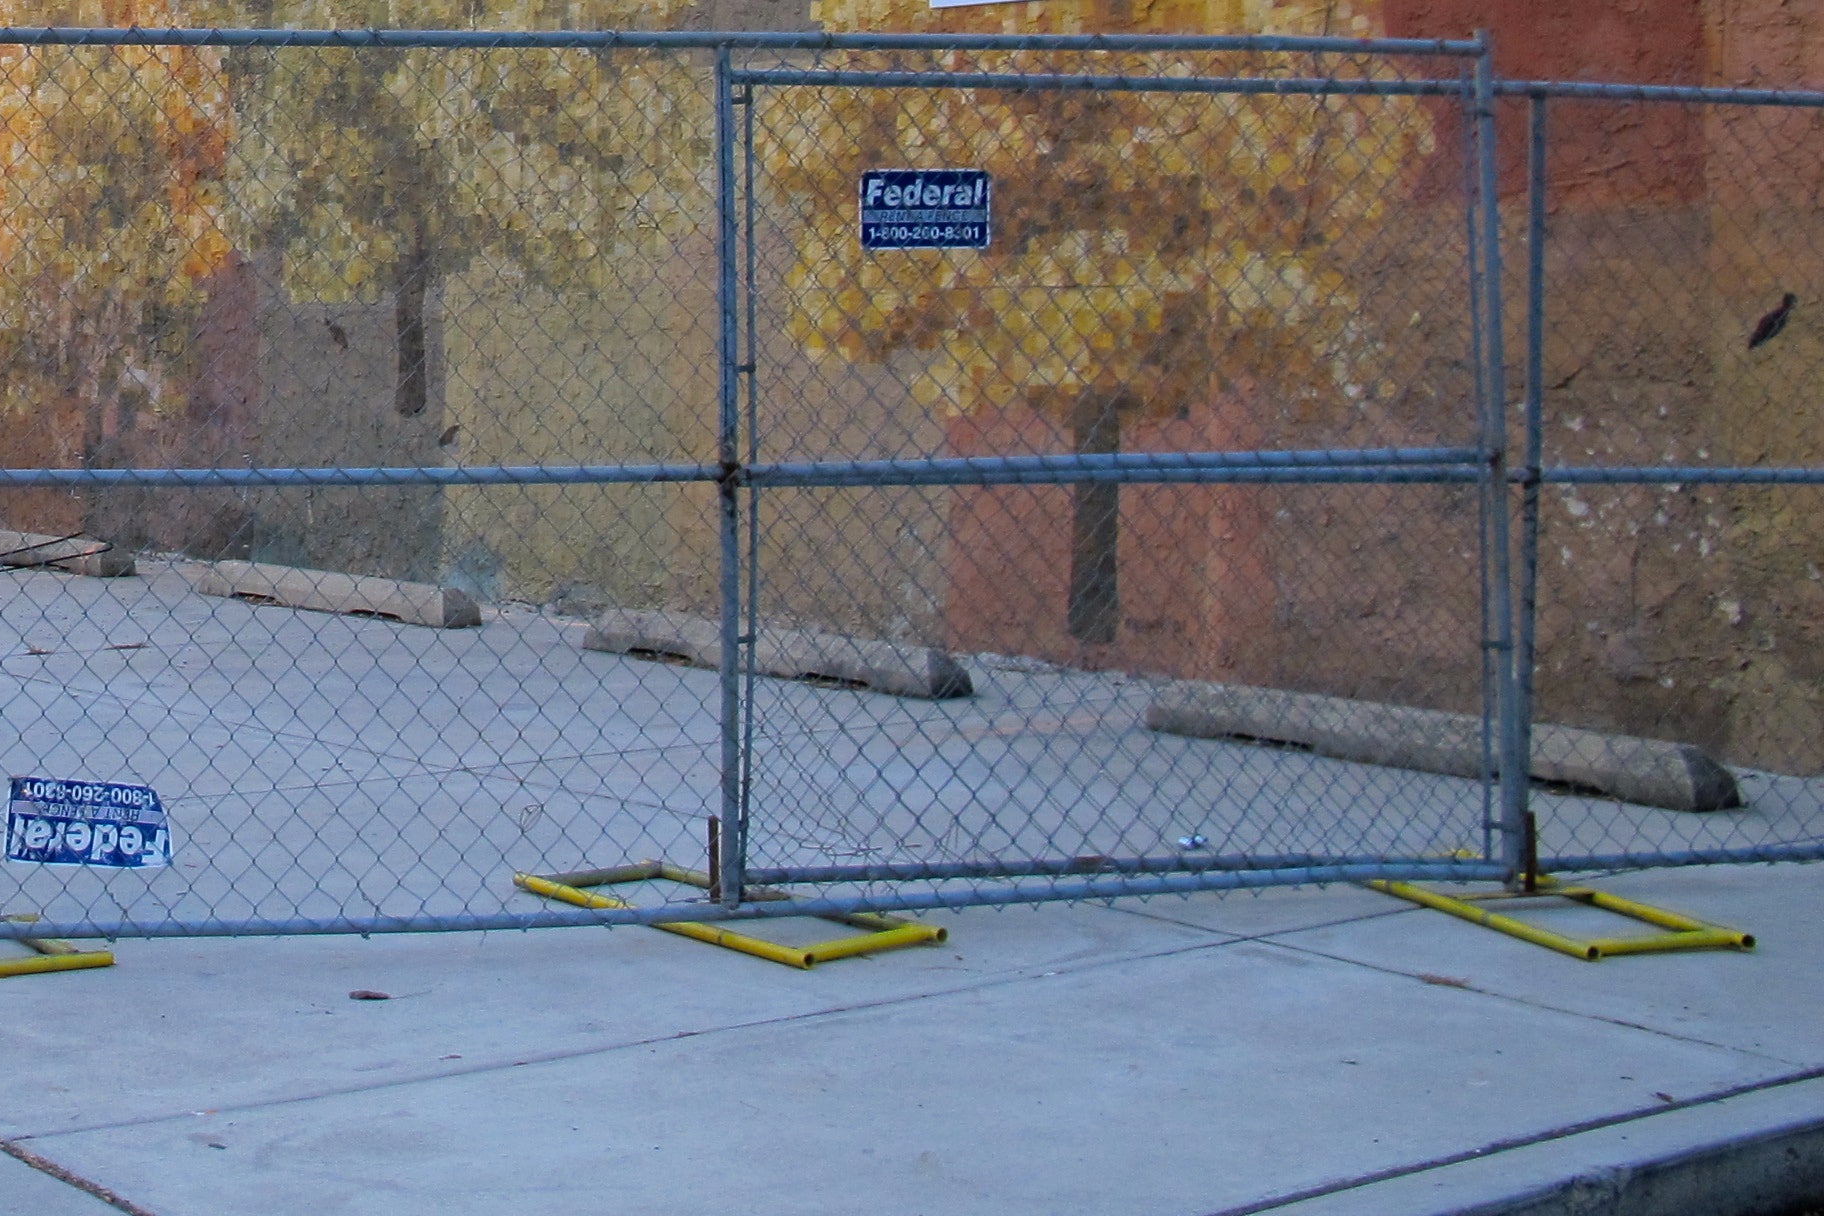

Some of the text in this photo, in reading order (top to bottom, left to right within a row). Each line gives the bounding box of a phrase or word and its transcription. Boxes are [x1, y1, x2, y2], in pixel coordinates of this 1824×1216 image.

[865, 178, 984, 206] Federal
[90, 804, 99, 816] A
[104, 806, 140, 821] RENT
[10, 815, 167, 863] Federal
